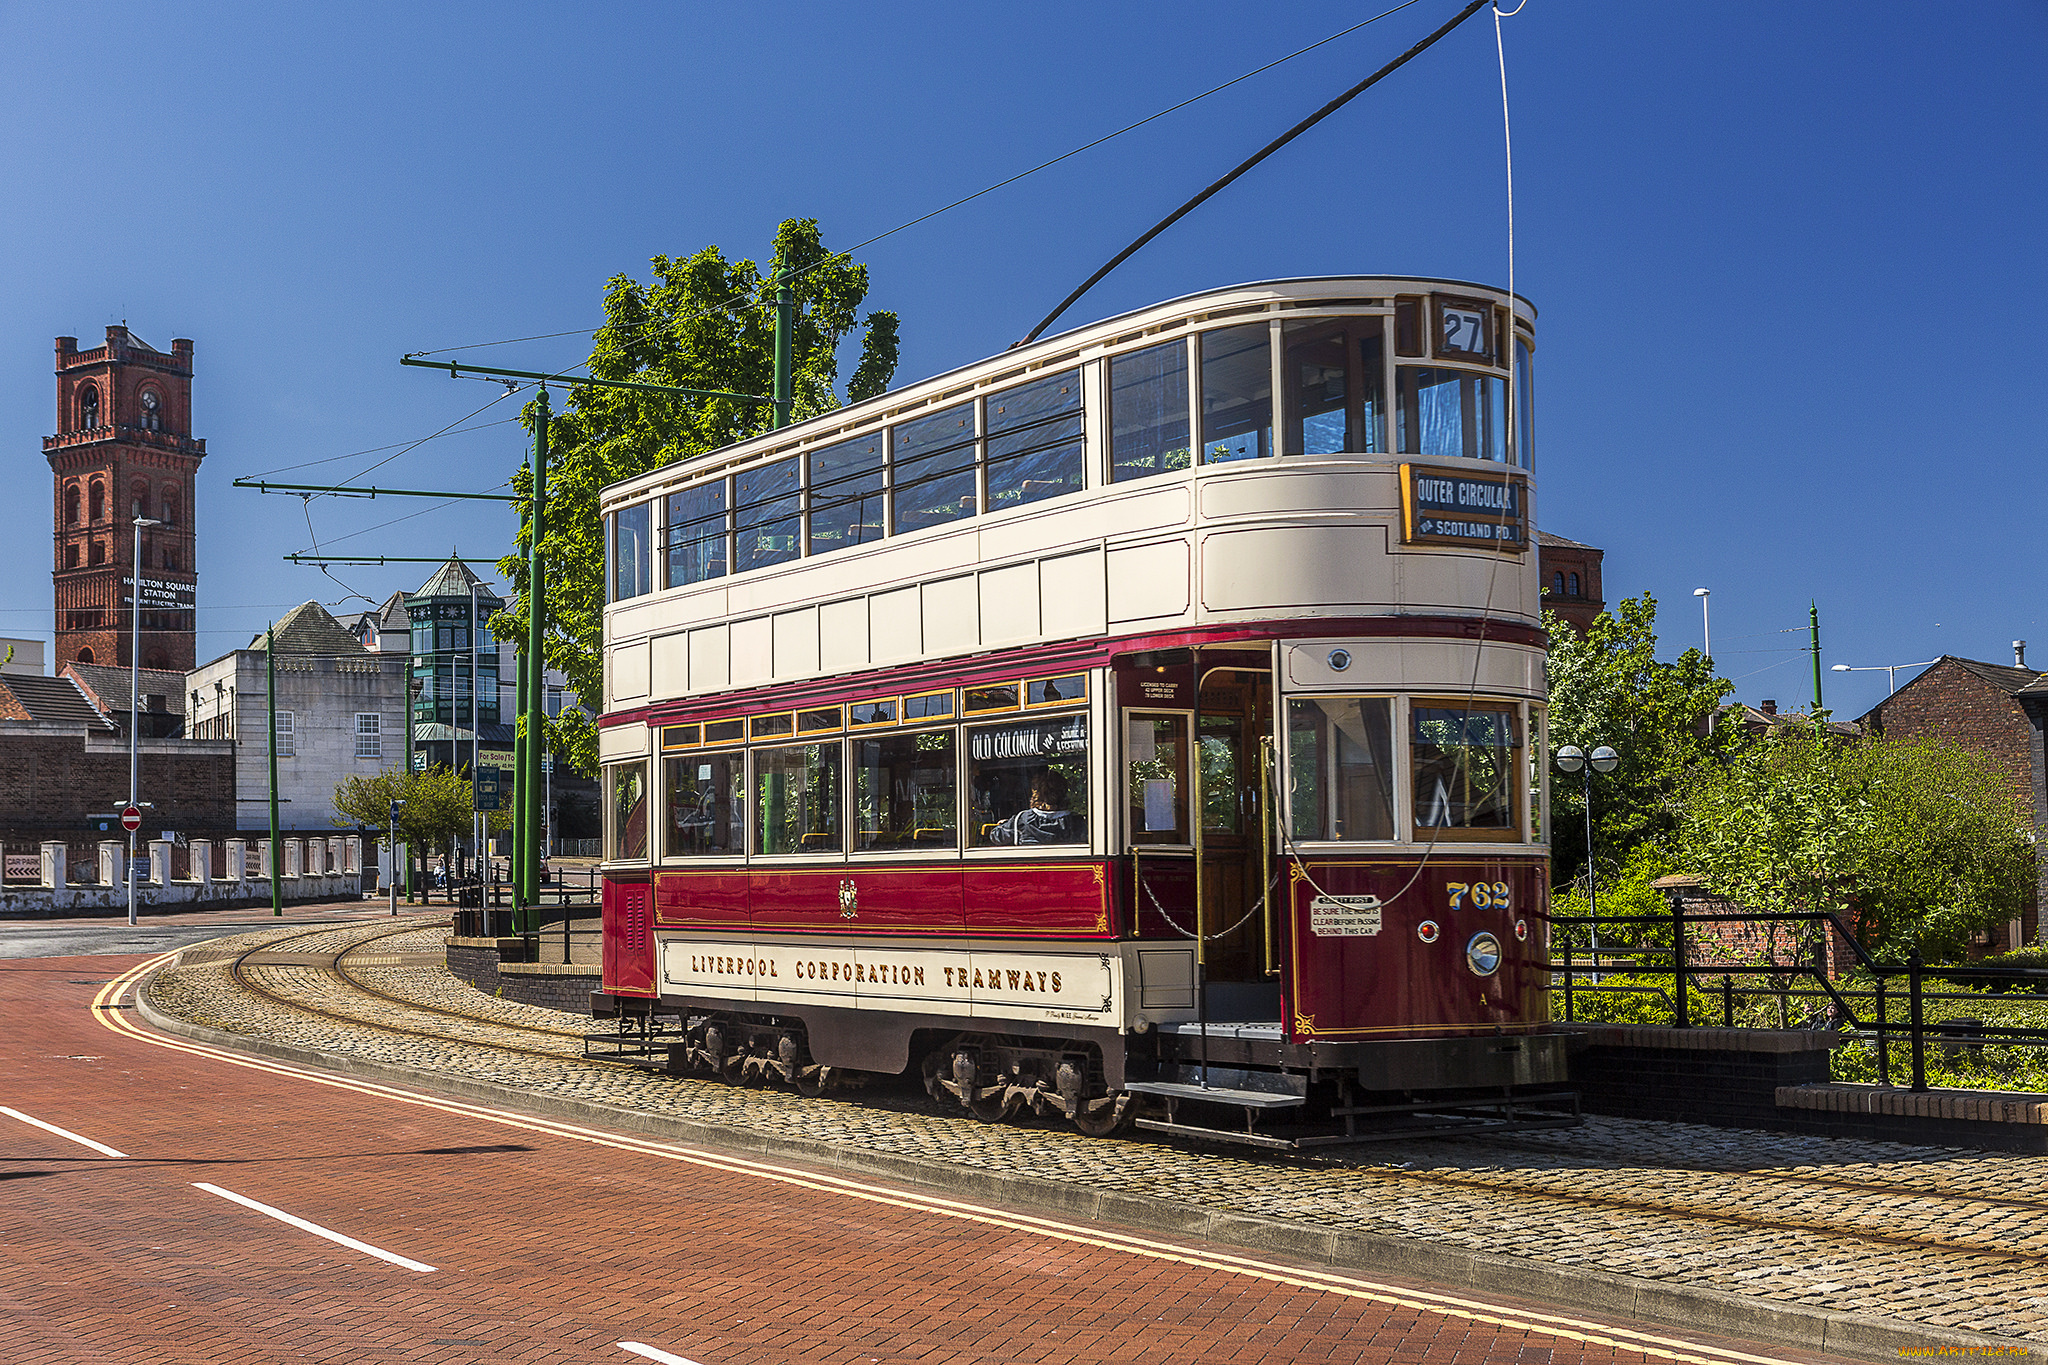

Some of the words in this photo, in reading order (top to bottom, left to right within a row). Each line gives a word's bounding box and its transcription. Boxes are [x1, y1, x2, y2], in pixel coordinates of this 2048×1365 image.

[1445, 313, 1480, 352] 27
[1418, 479, 1454, 504] OUTER
[1459, 482, 1512, 509] CIRCULAR
[1436, 521, 1491, 539] SCOTLAND
[144, 588, 176, 600] STATION
[165, 581, 195, 593] SQUARE
[973, 734, 991, 760] OLD
[995, 729, 1044, 758] COLONIAL
[480, 752, 489, 761] For
[1446, 881, 1509, 910] 762
[1313, 907, 1321, 915] BE
[1322, 907, 1340, 915] SURE
[1340, 907, 1353, 915] THE
[1313, 918, 1333, 926] CLEAR
[1317, 927, 1342, 935] BEHIND
[691, 955, 778, 977] LIVERPOOL
[795, 960, 925, 986] CORPORATION
[943, 966, 1063, 993] TRAMWAYS
[1479, 992, 1488, 1006] A
